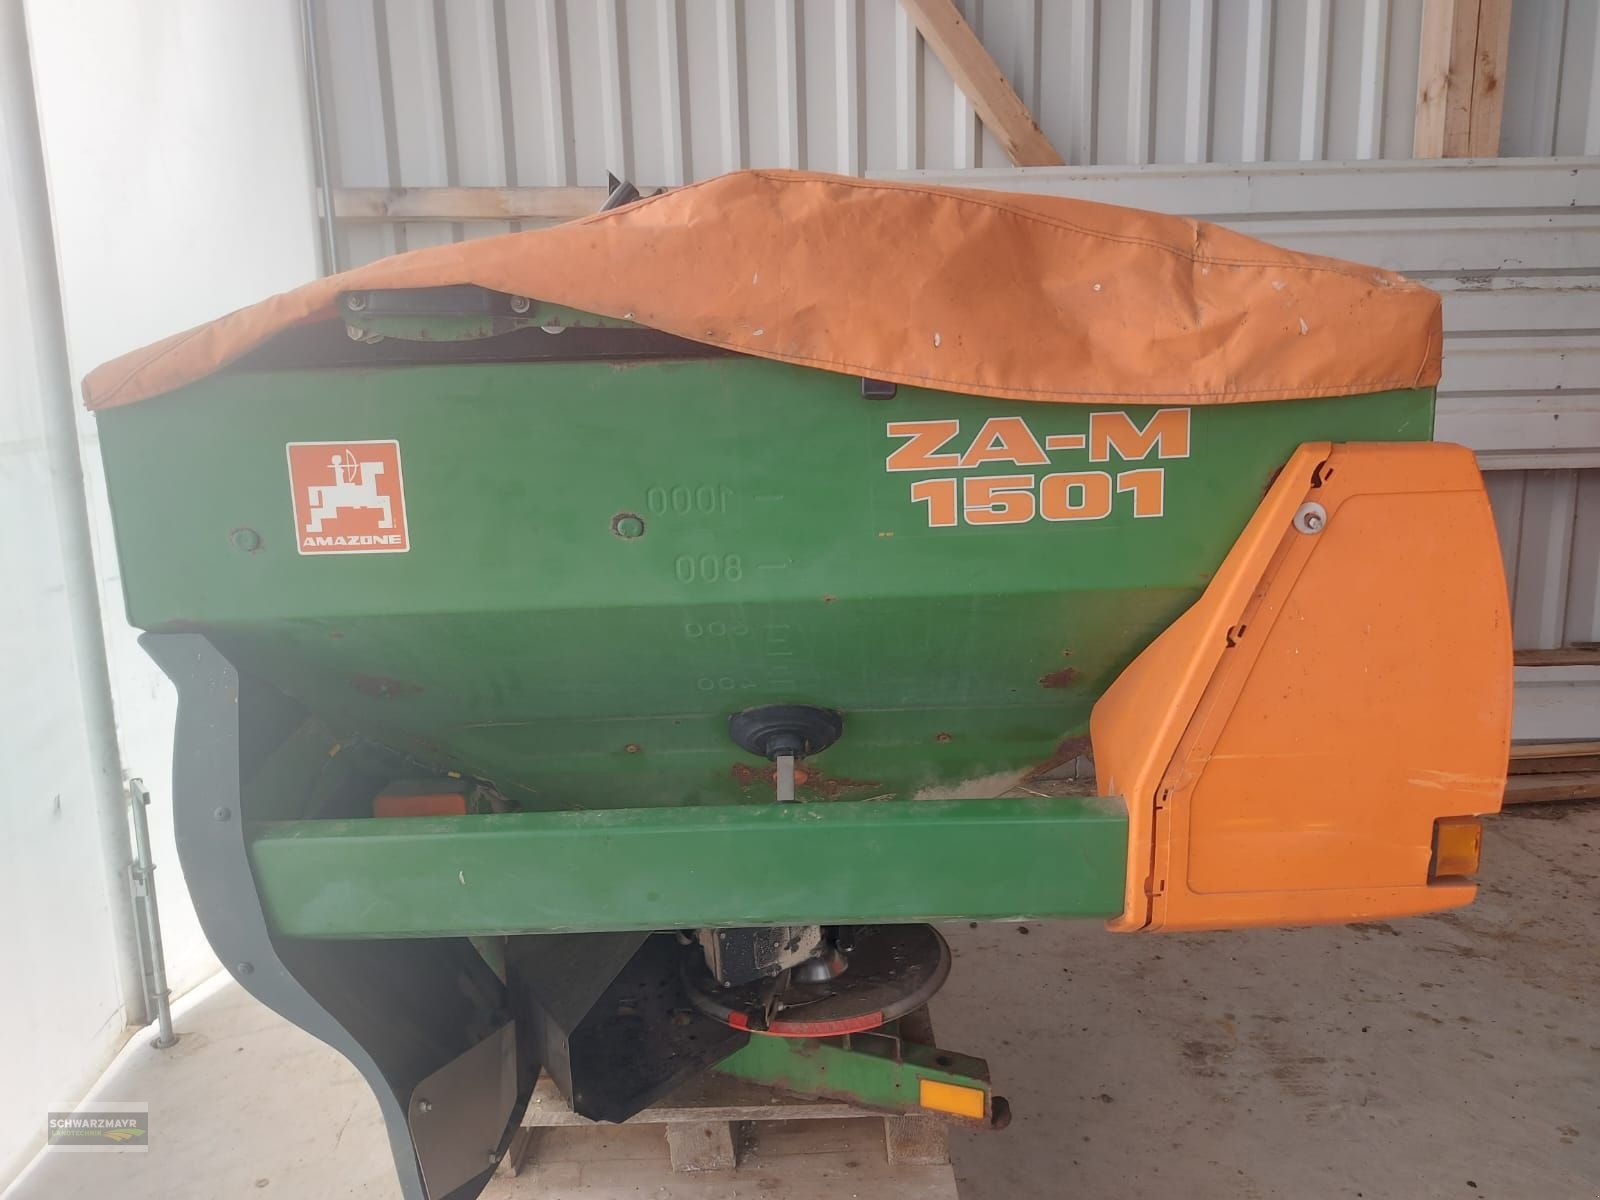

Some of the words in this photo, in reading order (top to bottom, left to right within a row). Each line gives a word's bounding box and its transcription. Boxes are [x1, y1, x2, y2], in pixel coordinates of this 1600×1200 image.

[886, 408, 1191, 472] ZA-M
[911, 468, 1164, 527] 1501
[303, 535, 402, 547] AMAZONE
